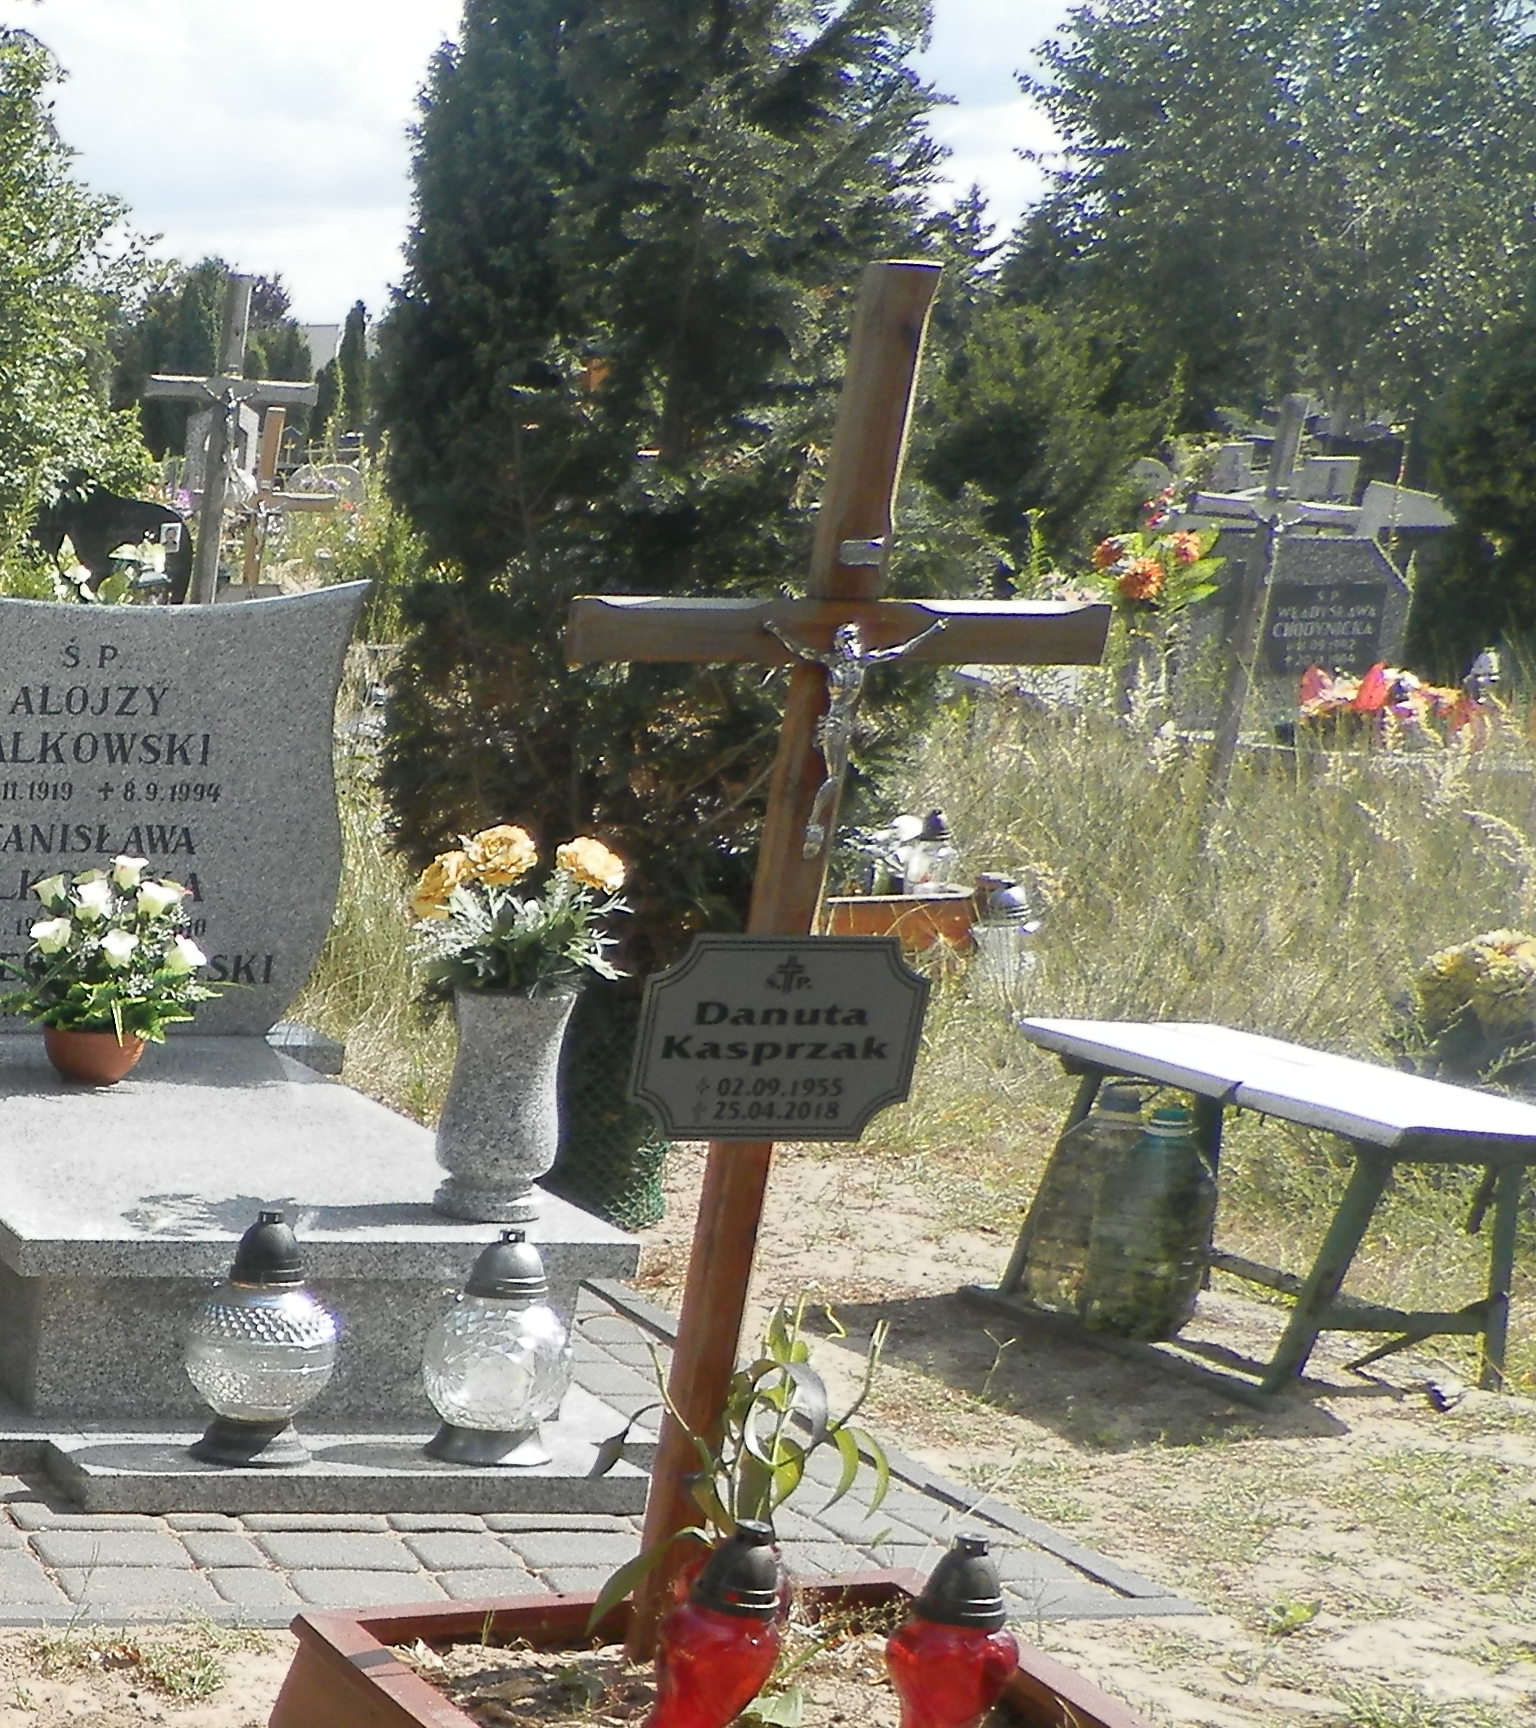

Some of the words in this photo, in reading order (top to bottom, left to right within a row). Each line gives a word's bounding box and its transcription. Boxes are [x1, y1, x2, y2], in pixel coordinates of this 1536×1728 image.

[8, 685, 170, 717] ALOJZY
[694, 1001, 869, 1027] Danuta
[660, 1035, 890, 1067] Kasprzak
